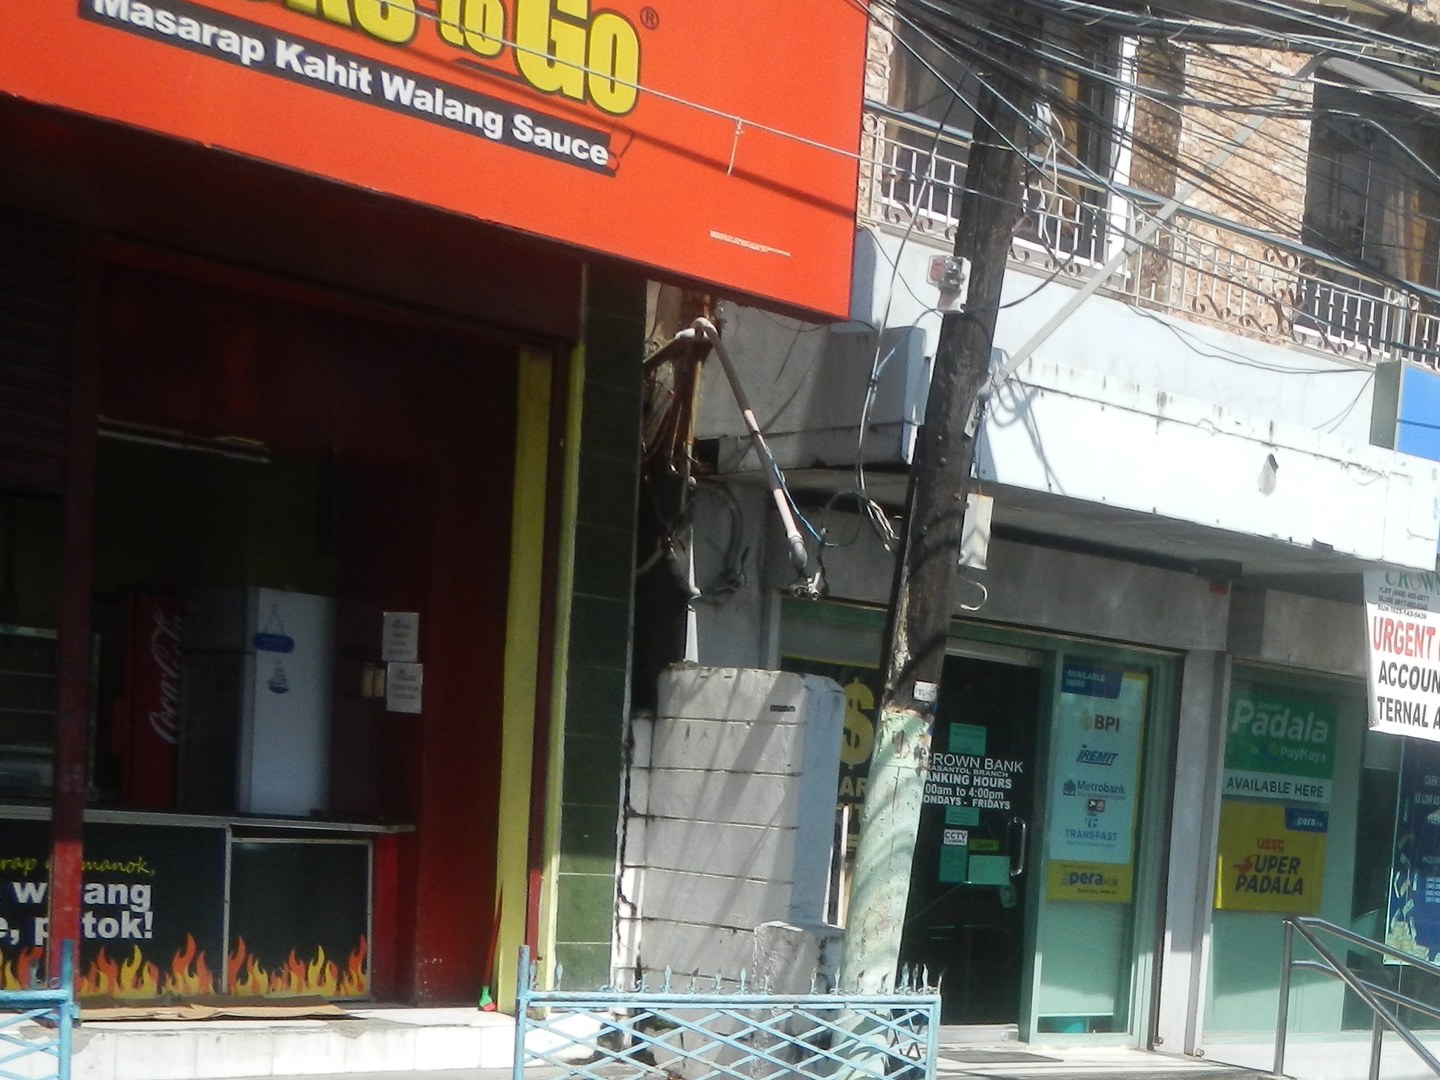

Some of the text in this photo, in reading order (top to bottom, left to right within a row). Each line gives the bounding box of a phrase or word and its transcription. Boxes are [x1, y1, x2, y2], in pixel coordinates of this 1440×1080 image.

[516, 0, 639, 115] Go
[92, 0, 267, 66] Masarap
[275, 38, 372, 95] Kahit
[381, 70, 503, 140] Walang
[511, 114, 609, 166] Sauce
[1373, 616, 1436, 660] URGENT
[1094, 714, 1120, 732] BPI
[1230, 700, 1329, 744] Padala
[927, 752, 1023, 773] ROWN BANK
[926, 771, 1012, 789] ANKING HOURS
[973, 769, 1009, 778] BRANCH
[956, 786, 966, 797] to
[968, 787, 1005, 800] 4:00pm
[1077, 780, 1126, 795] Metrobank
[1226, 777, 1324, 798] AVAILABLE HERE
[923, 794, 961, 806] ONDAYS
[972, 799, 1011, 810] FRIDAYS
[944, 831, 967, 840] CCTV
[1065, 828, 1117, 841] TRANSFAST
[1235, 873, 1304, 896] PADALA
[12, 881, 152, 913] wang
[34, 910, 154, 946] ptok!
